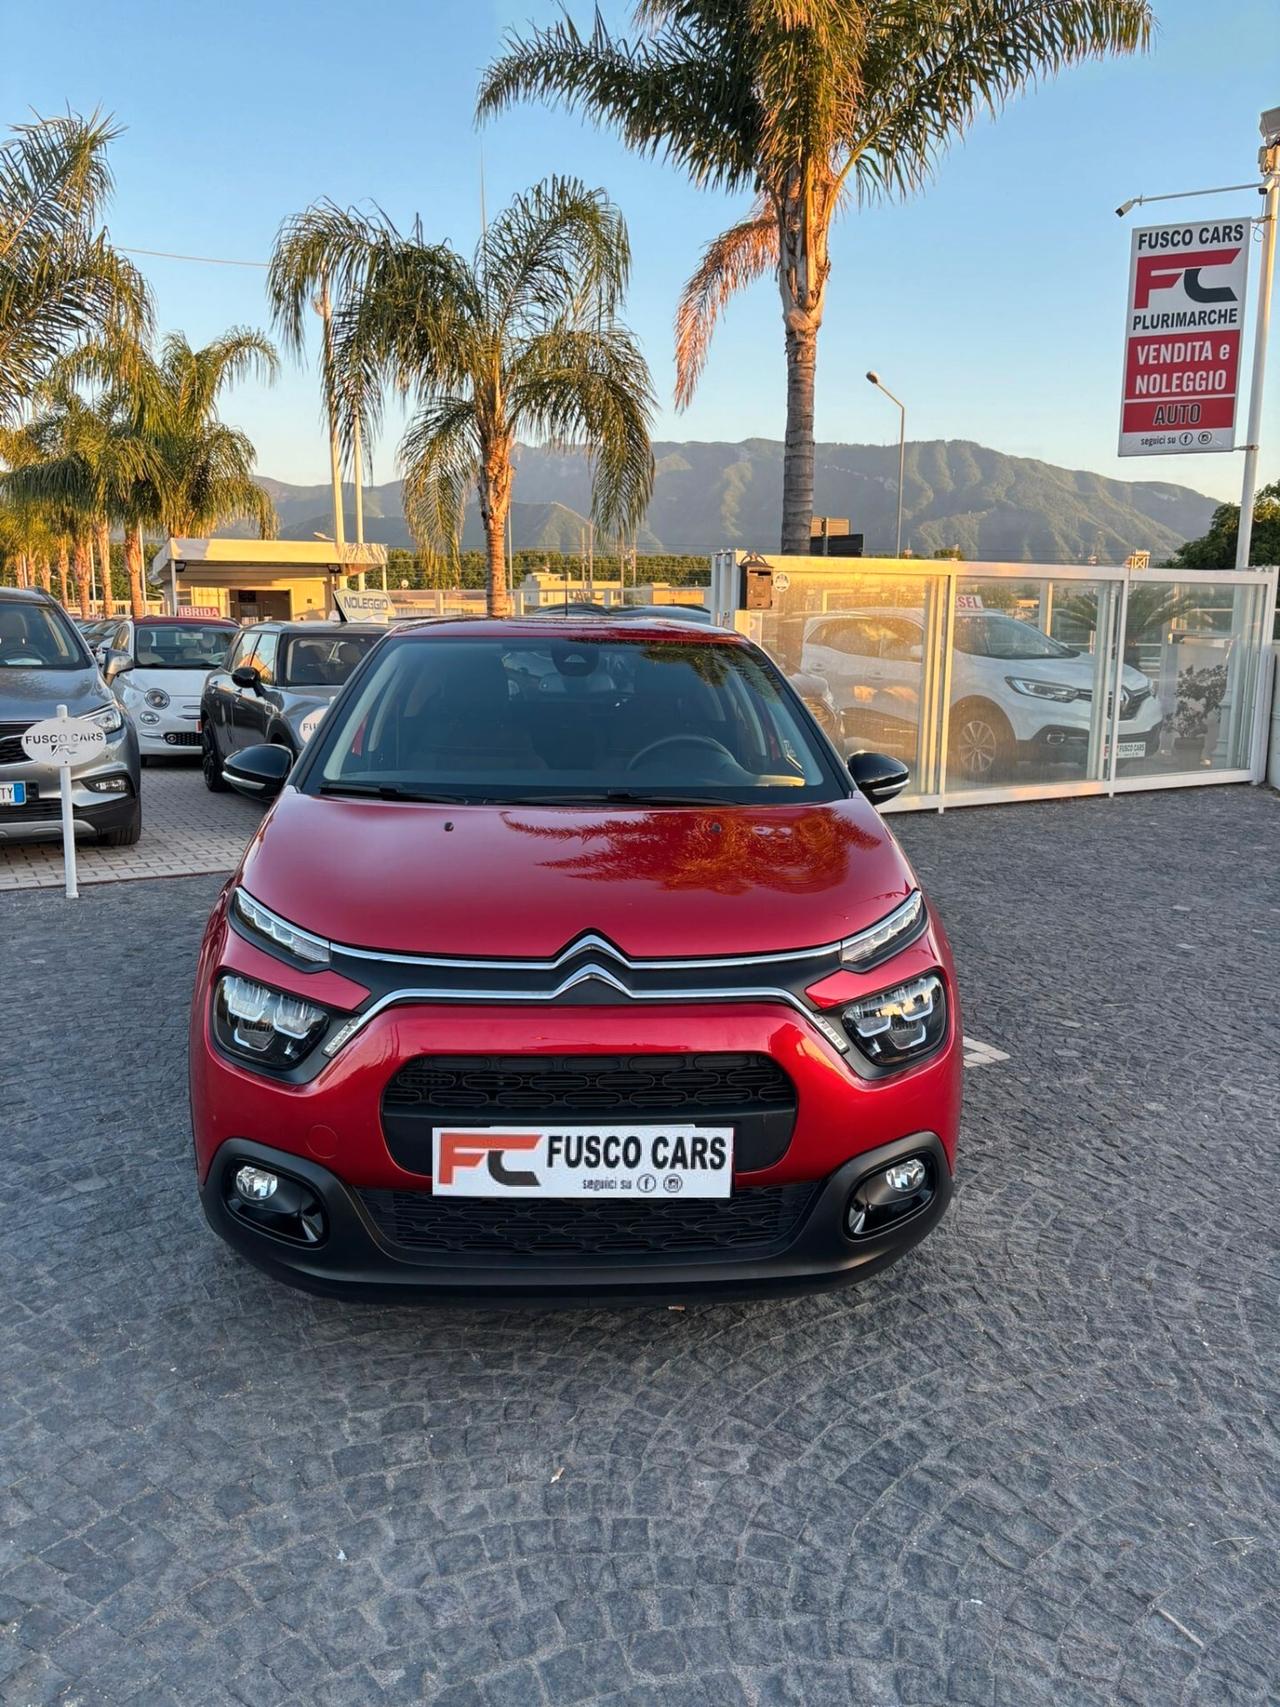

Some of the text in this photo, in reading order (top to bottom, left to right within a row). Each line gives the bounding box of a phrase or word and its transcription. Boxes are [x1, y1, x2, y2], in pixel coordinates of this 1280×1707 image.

[1138, 223, 1244, 250] FUSCO CARS
[1133, 308, 1238, 330] PLURIMARCHE
[1137, 341, 1230, 365] VENDITA e
[1135, 370, 1227, 395] NOLEGGIO
[1153, 404, 1201, 425] AUTO
[1140, 435, 1176, 447] seguici su
[180, 607, 219, 617] IBRIDA
[344, 596, 388, 609] NOLEGGIO
[25, 732, 104, 744] FUSCO CARS
[547, 1135, 726, 1170] FUSCO CARS
[582, 1176, 632, 1190] seguici su
